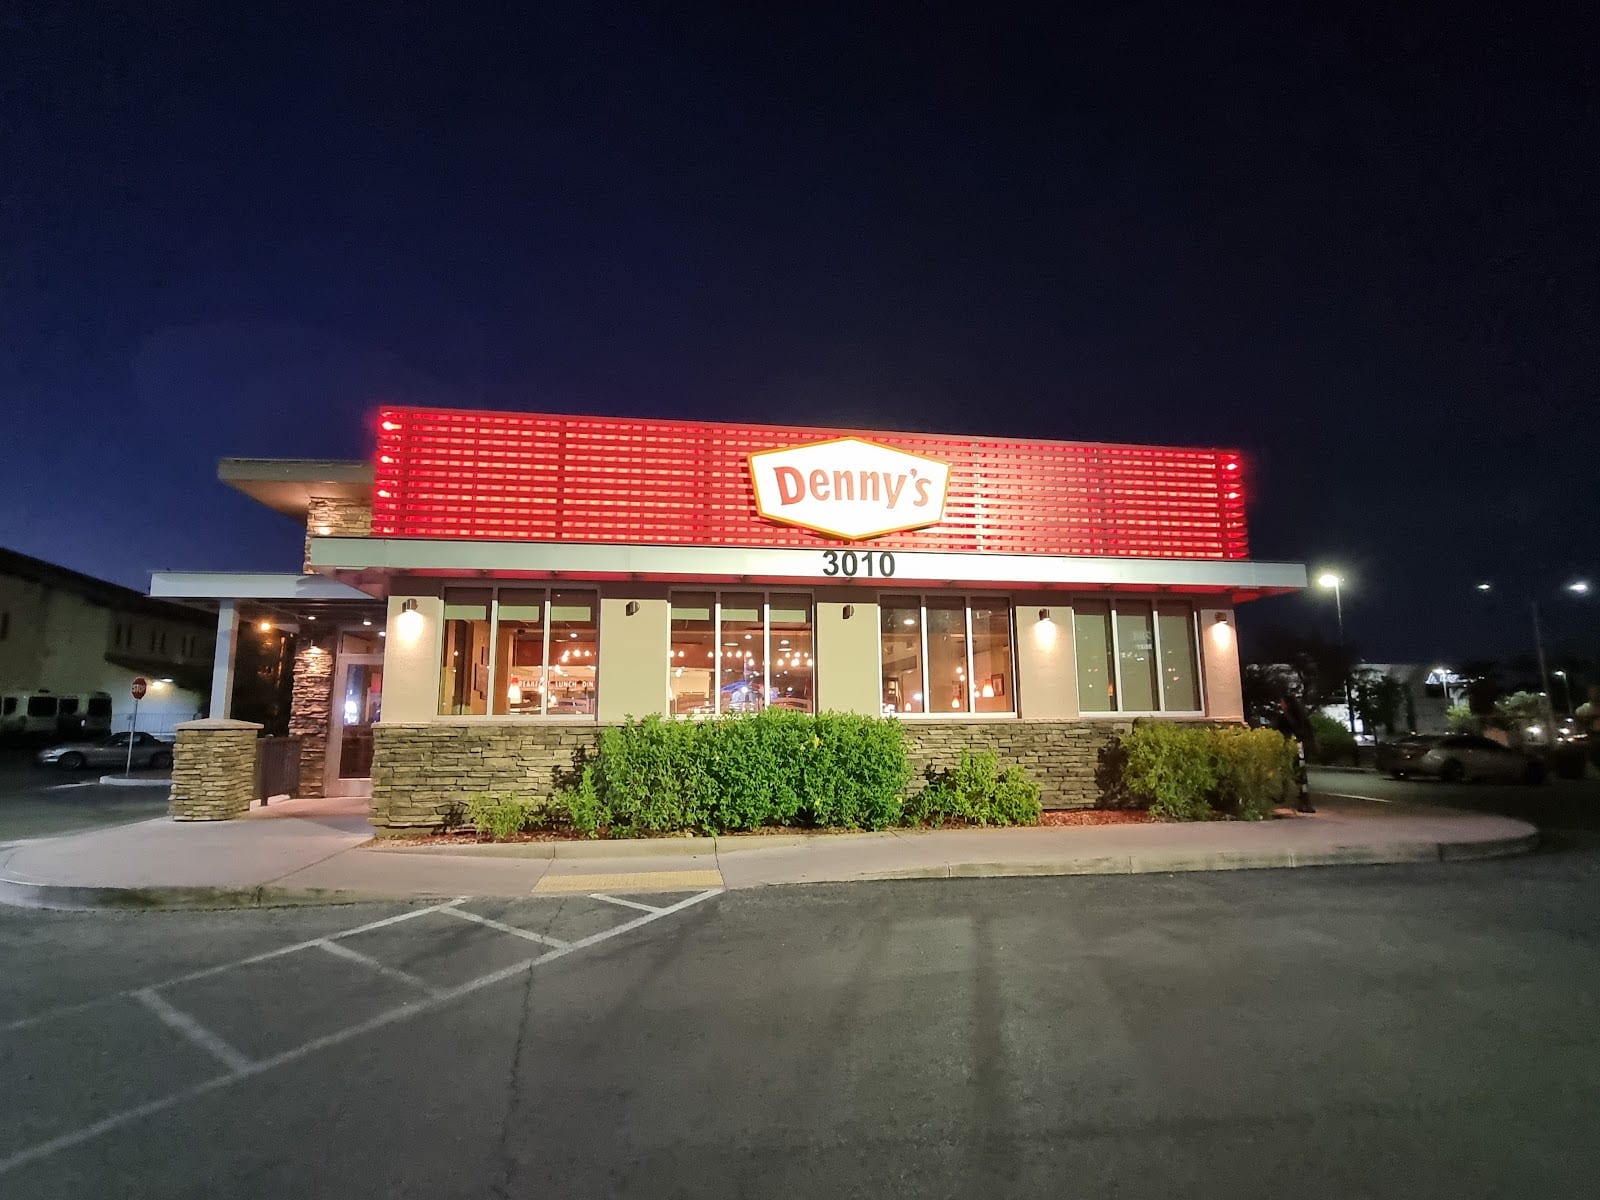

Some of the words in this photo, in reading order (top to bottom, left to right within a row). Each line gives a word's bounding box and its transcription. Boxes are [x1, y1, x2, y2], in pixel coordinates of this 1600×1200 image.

[773, 466, 931, 509] Denny's
[822, 550, 895, 577] 3010
[555, 680, 577, 688] LUNCH
